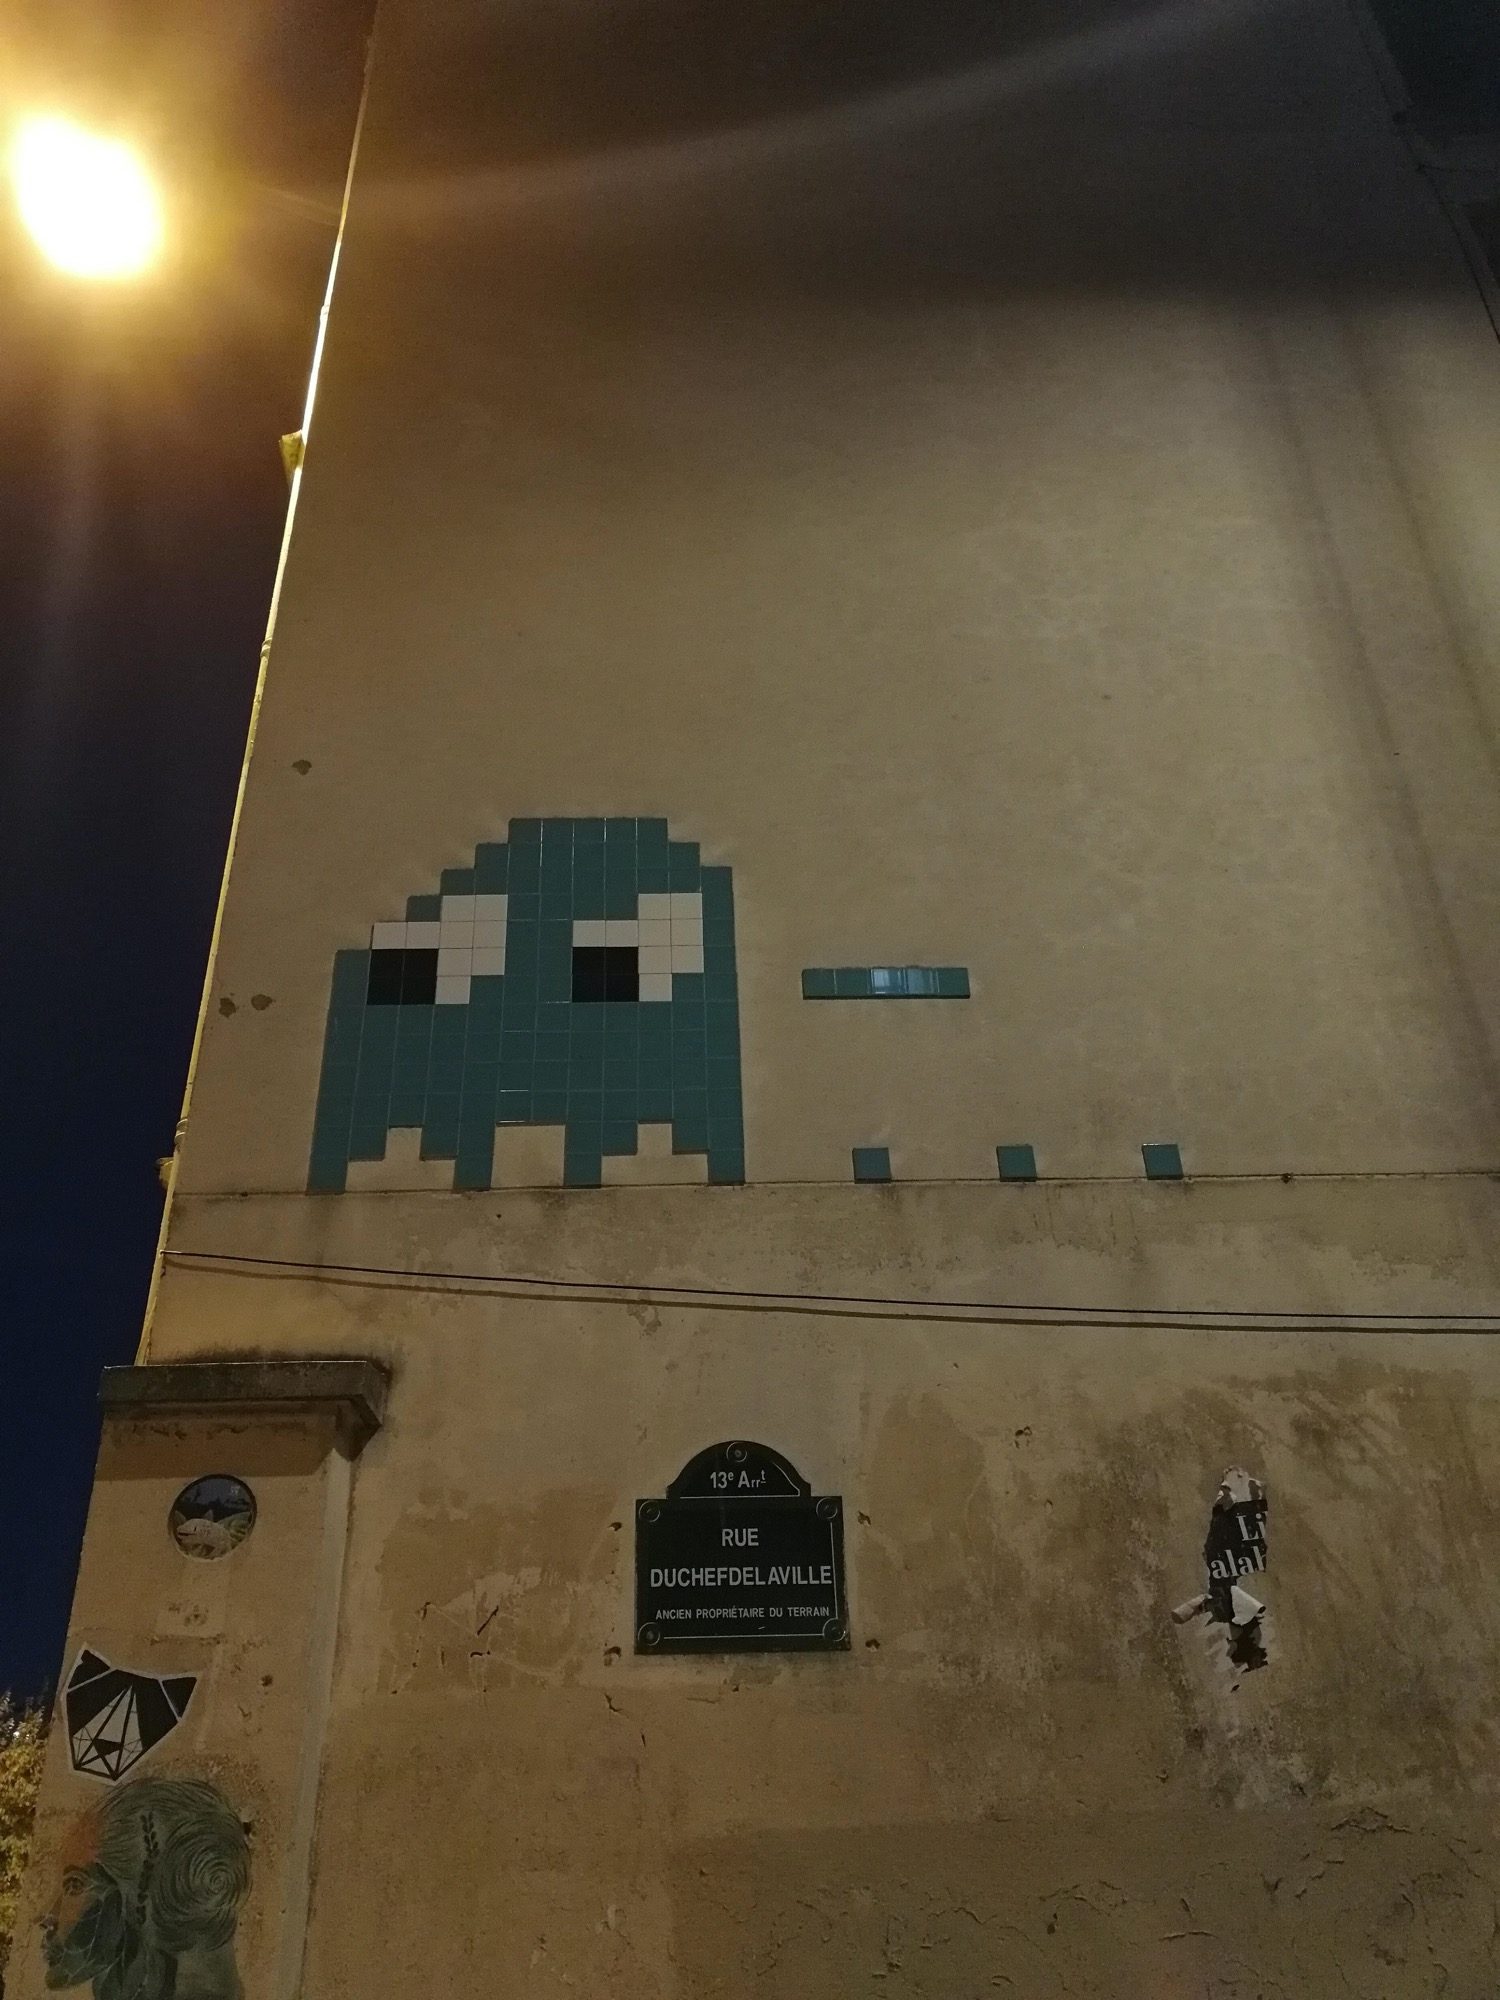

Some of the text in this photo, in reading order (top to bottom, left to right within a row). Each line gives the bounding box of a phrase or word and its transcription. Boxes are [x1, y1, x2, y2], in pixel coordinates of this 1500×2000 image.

[709, 1471, 734, 1489] 13e
[721, 1528, 759, 1547] RUE
[649, 1565, 833, 1588] DUCHEFDELAVILLE
[655, 1605, 830, 1620] ANCIEN PROPRIÉTAIRE DU TERRAIN
